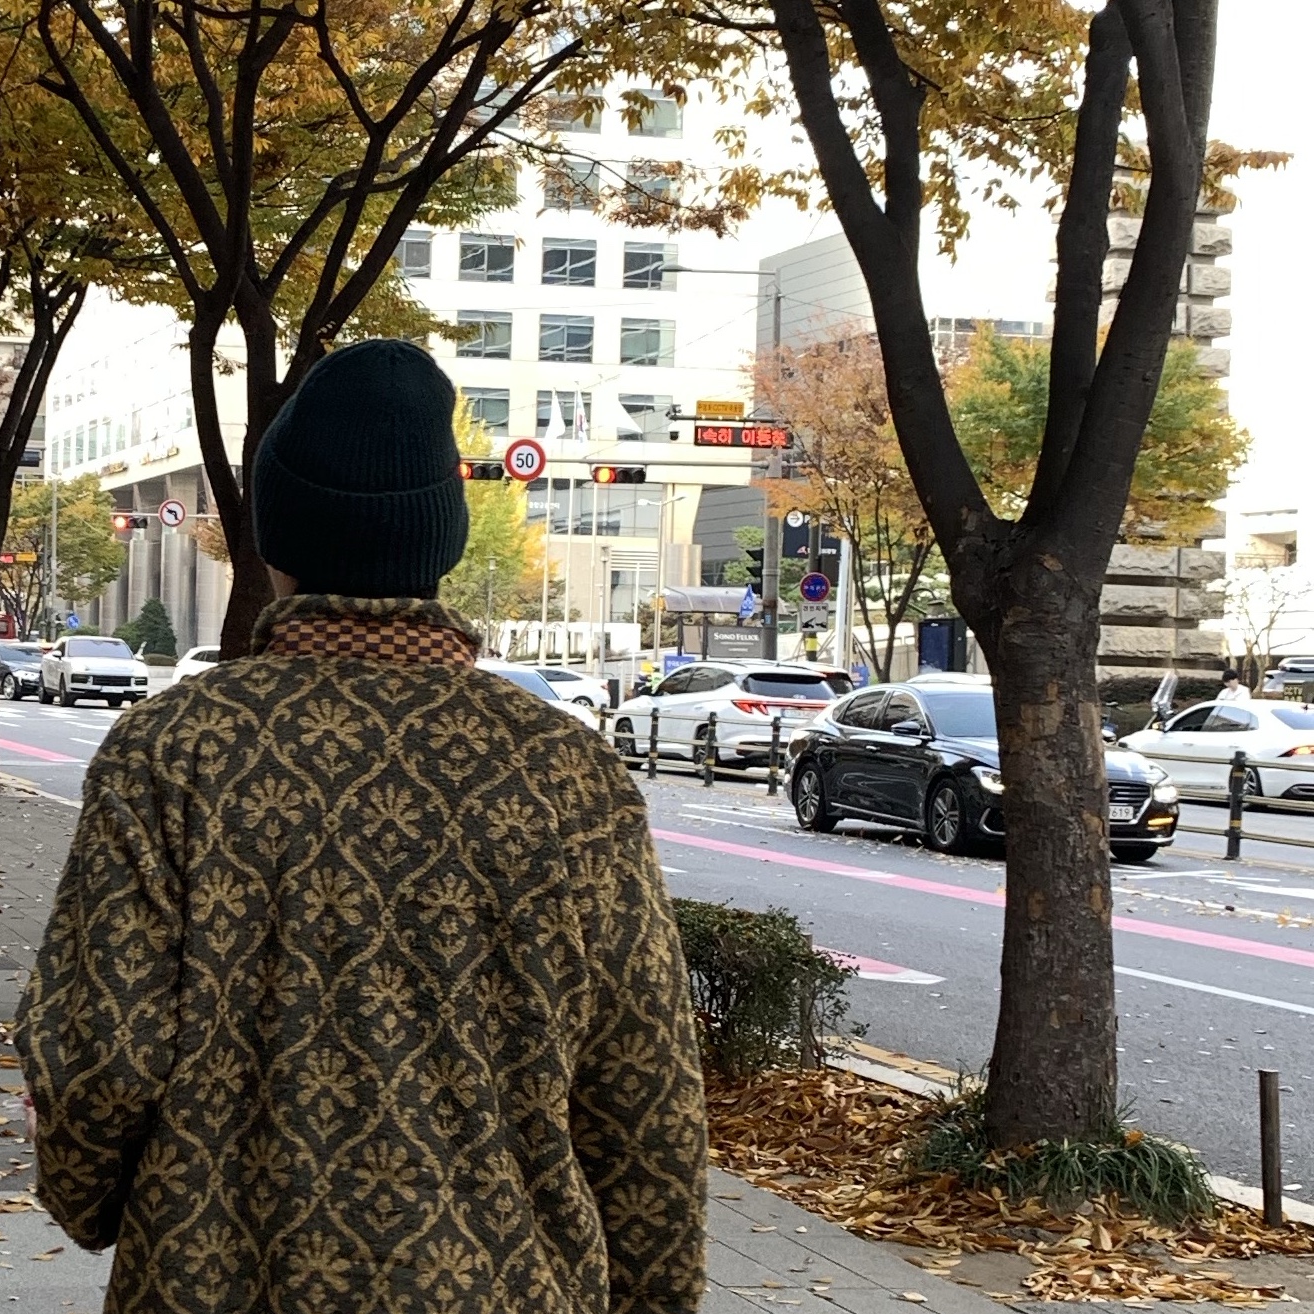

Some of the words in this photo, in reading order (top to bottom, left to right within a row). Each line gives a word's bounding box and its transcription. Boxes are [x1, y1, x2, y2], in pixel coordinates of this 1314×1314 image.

[516, 453, 534, 468] 50
[713, 632, 735, 640] SONO
[736, 633, 759, 641] FELICE
